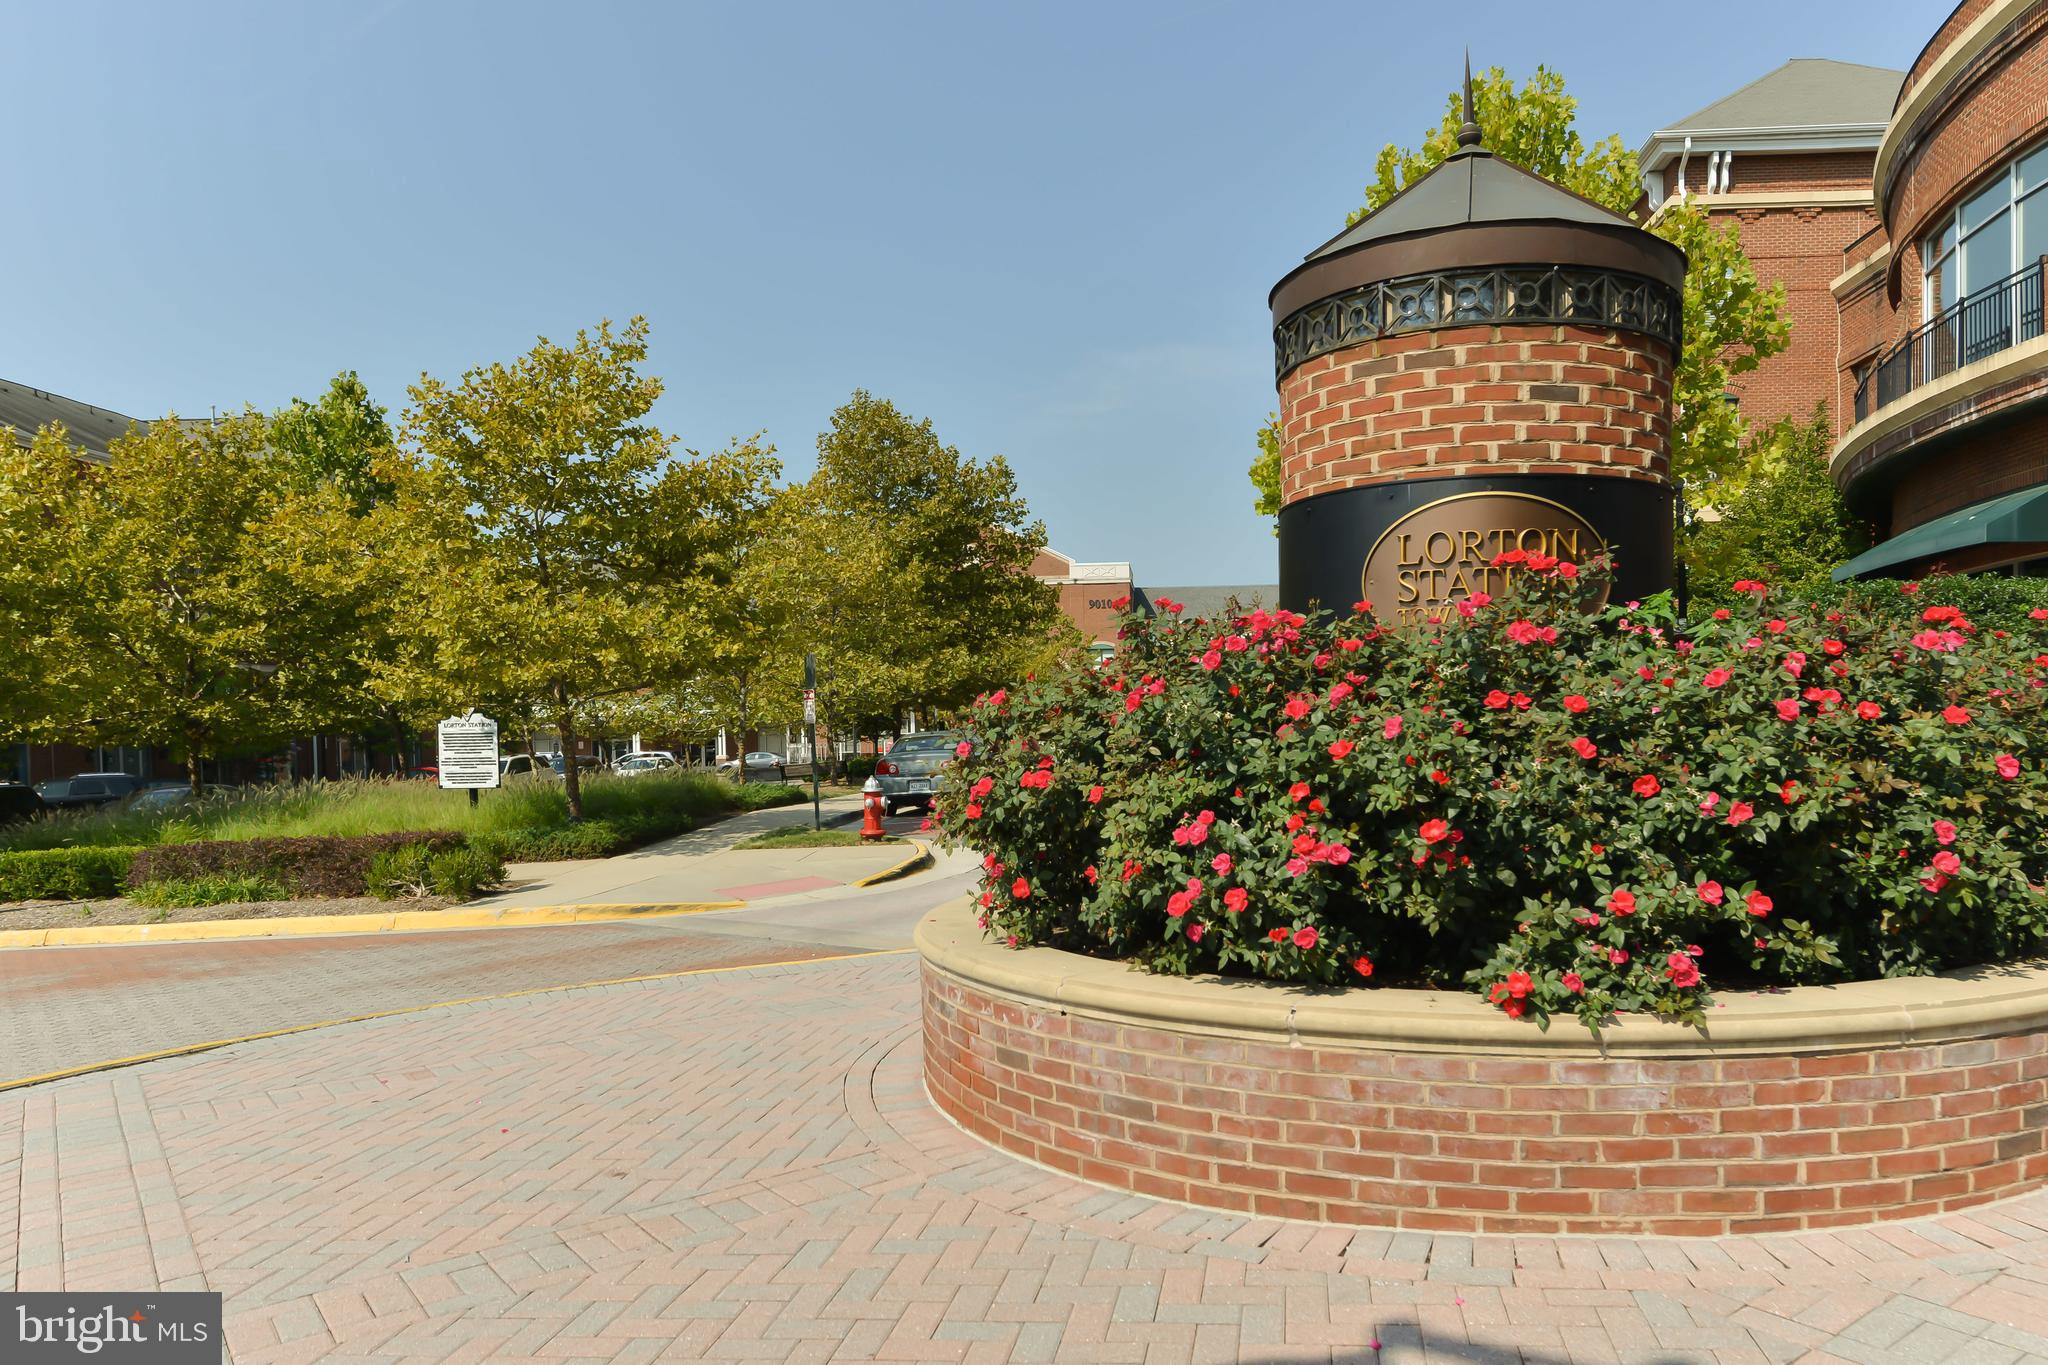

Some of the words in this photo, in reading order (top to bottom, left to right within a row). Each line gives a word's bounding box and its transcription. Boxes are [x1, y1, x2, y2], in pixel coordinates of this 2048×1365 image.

[1397, 528, 1580, 566] LORTON
[1397, 566, 1580, 603] STATI
[1088, 599, 1113, 609] 9010
